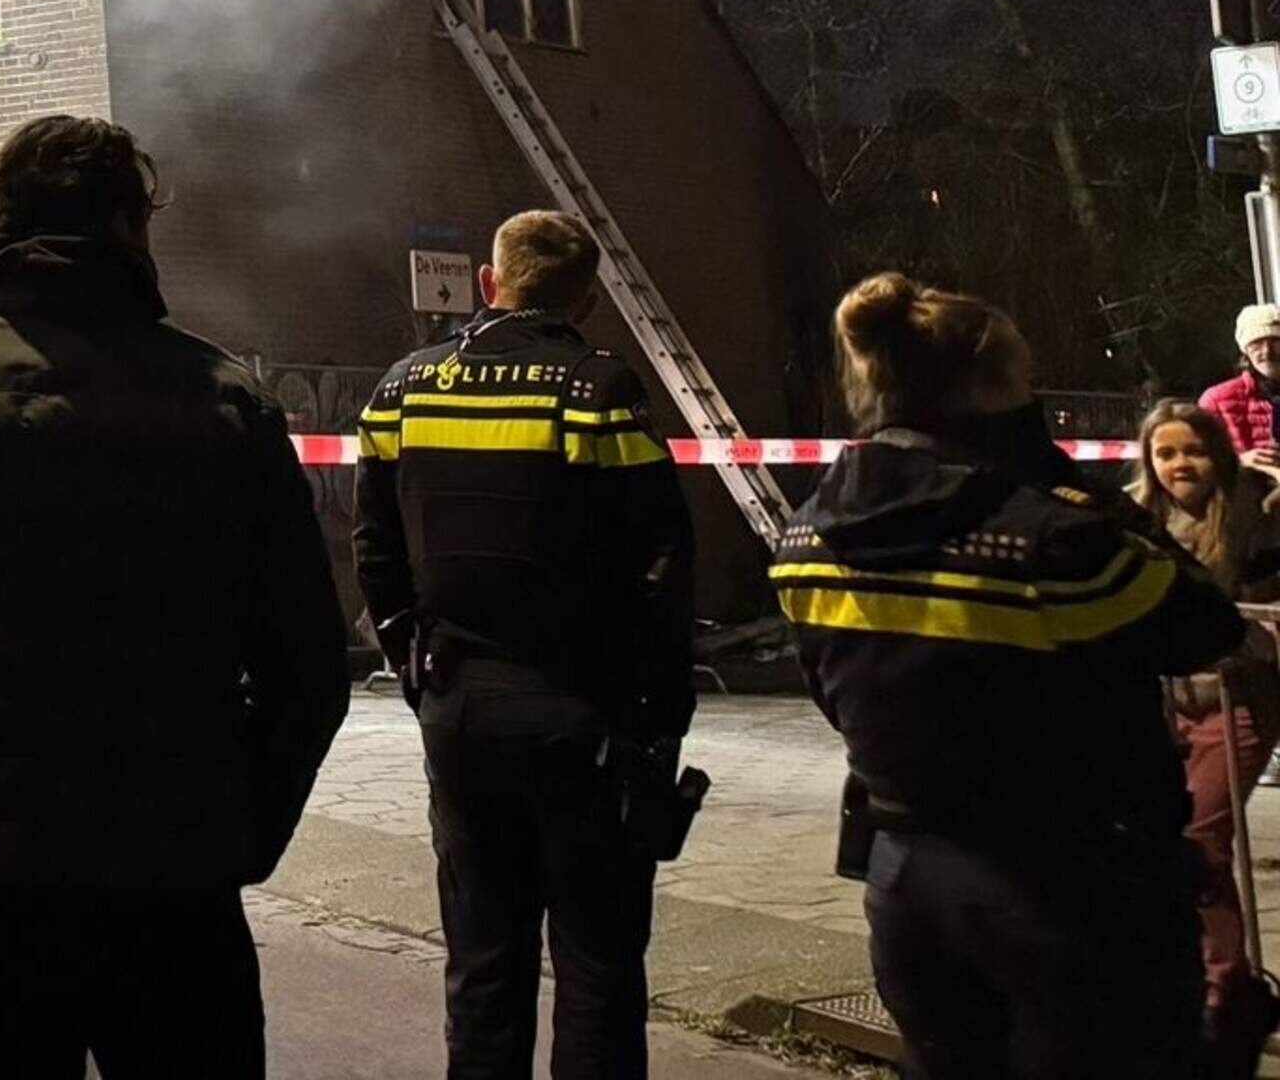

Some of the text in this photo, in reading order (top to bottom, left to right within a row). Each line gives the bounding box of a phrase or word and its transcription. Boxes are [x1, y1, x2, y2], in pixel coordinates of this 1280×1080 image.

[1244, 80, 1255, 95] 9
[416, 255, 430, 275] De
[421, 352, 544, 390] POLITIE
